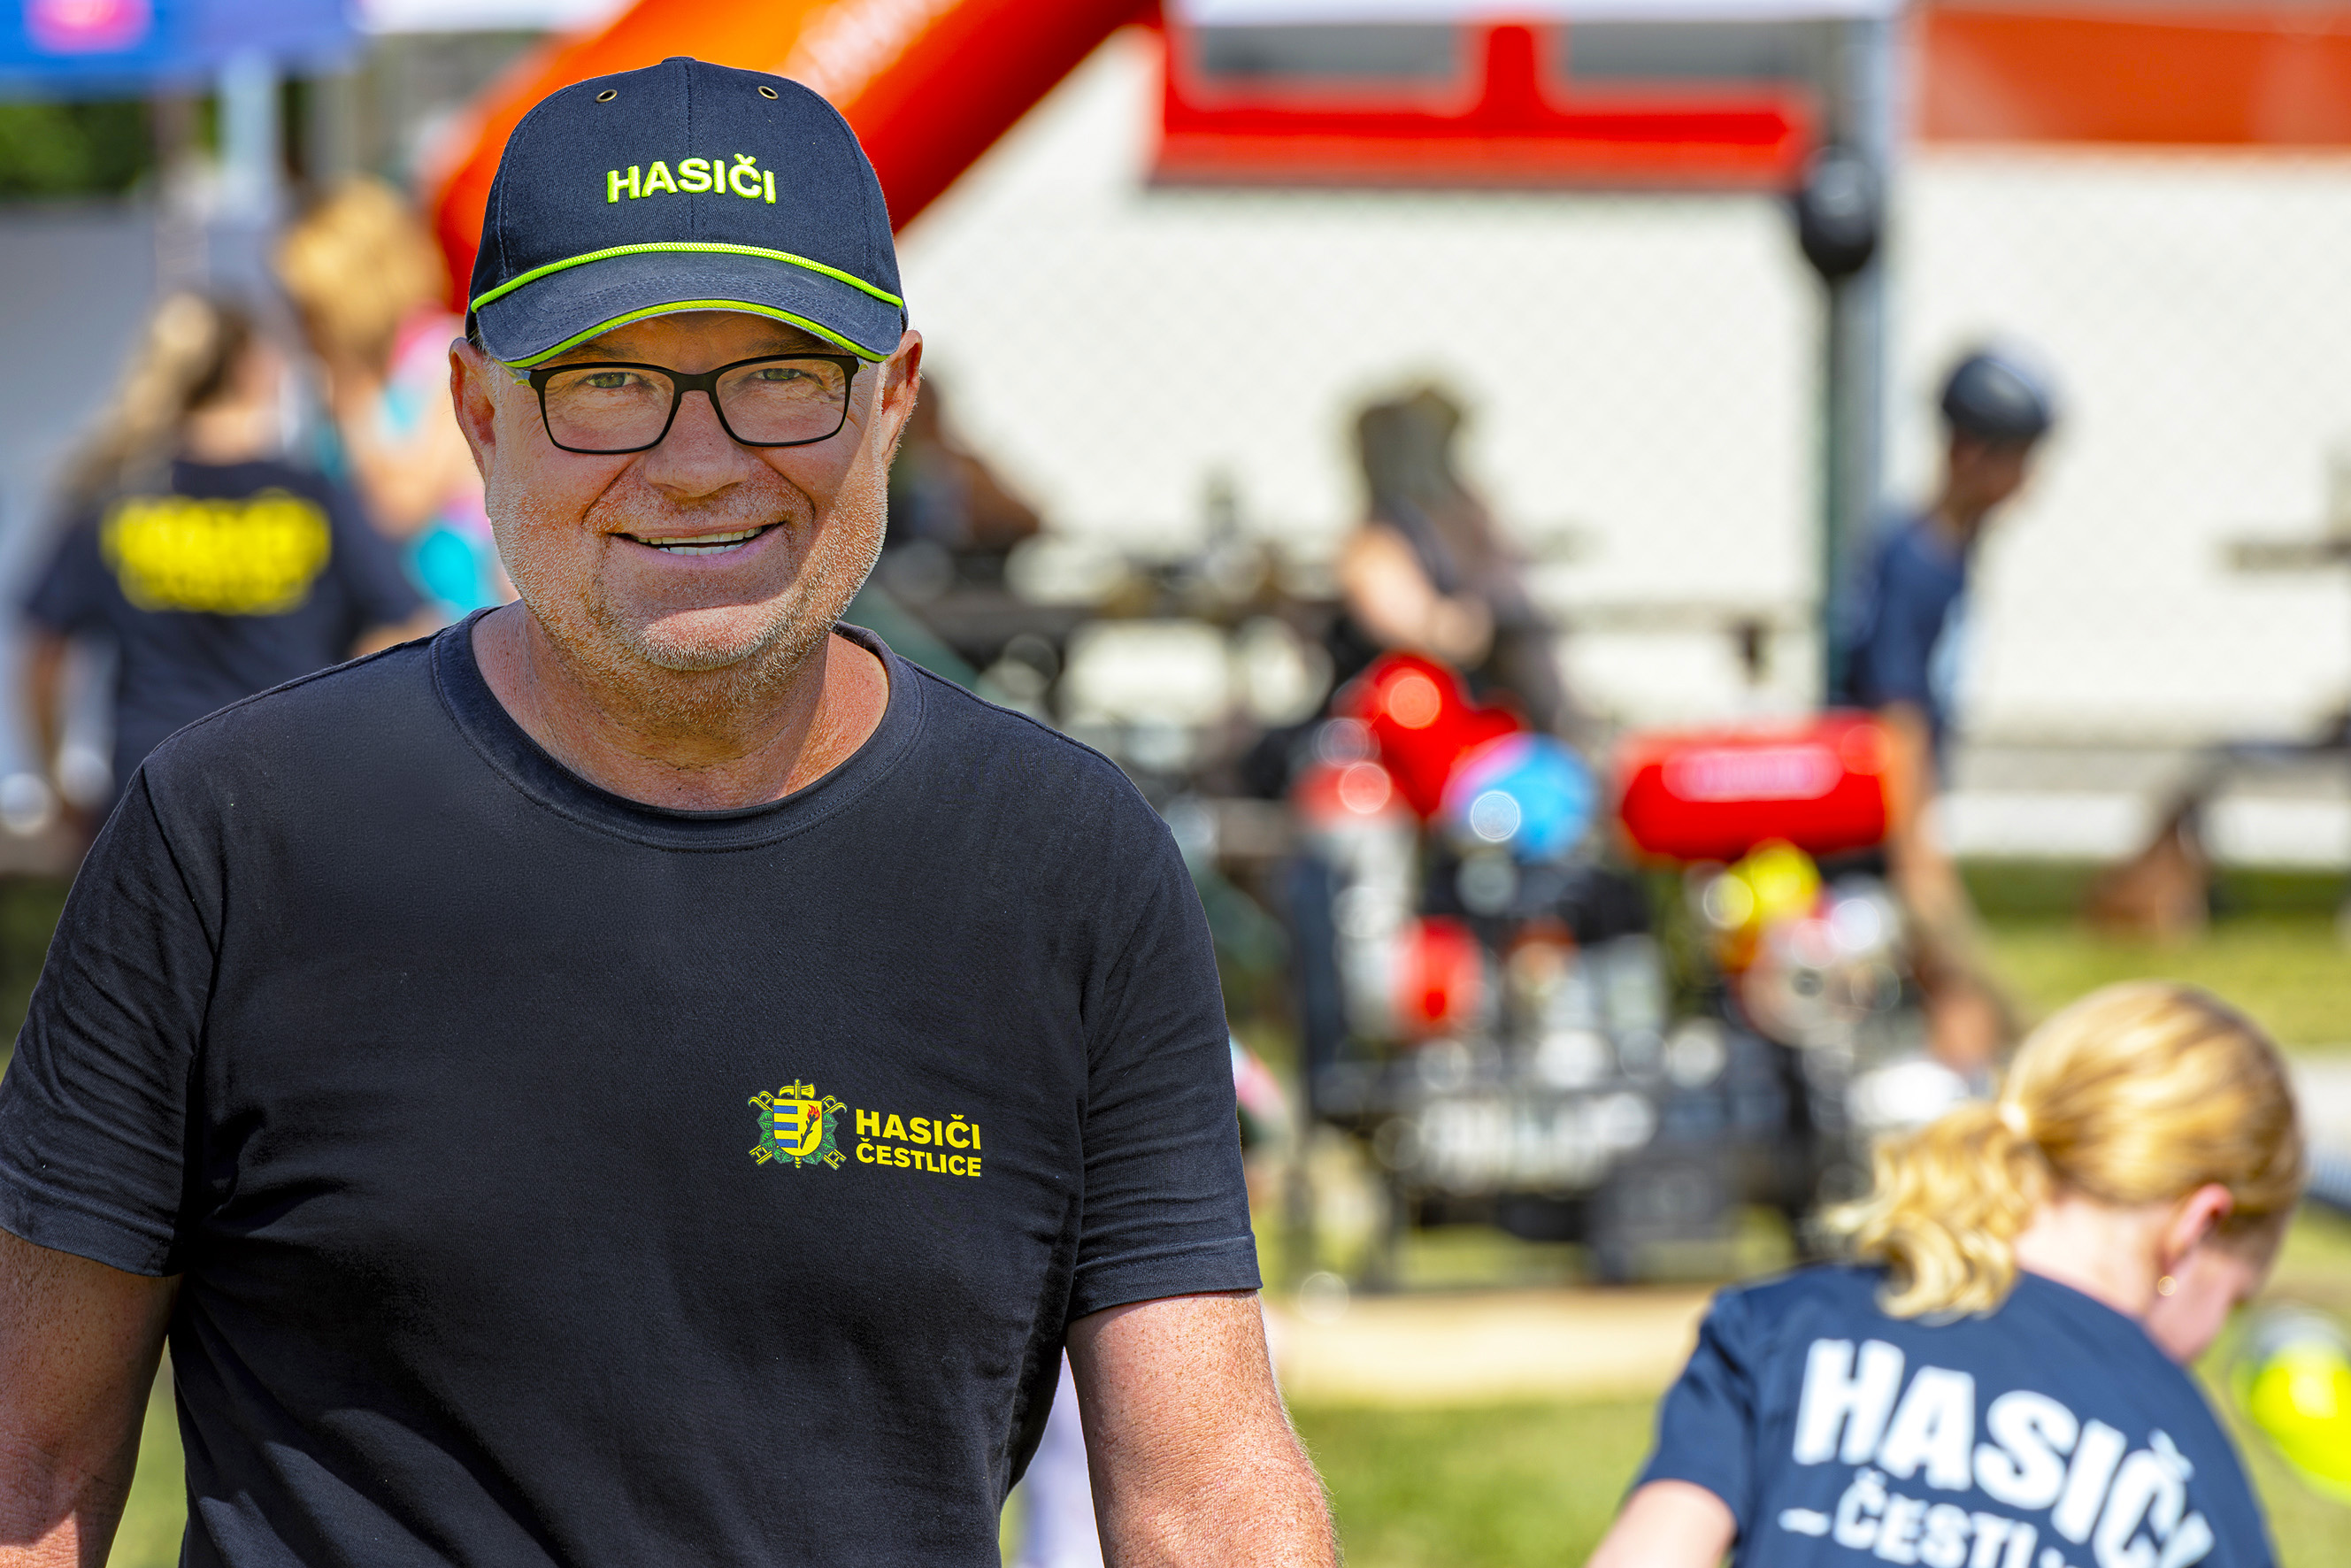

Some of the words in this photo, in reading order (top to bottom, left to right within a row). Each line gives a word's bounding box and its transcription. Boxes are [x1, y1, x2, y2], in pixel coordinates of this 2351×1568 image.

[607, 152, 776, 204] HASIČI
[855, 1108, 982, 1150] HASIČI
[855, 1137, 982, 1178] ČESTLICE
